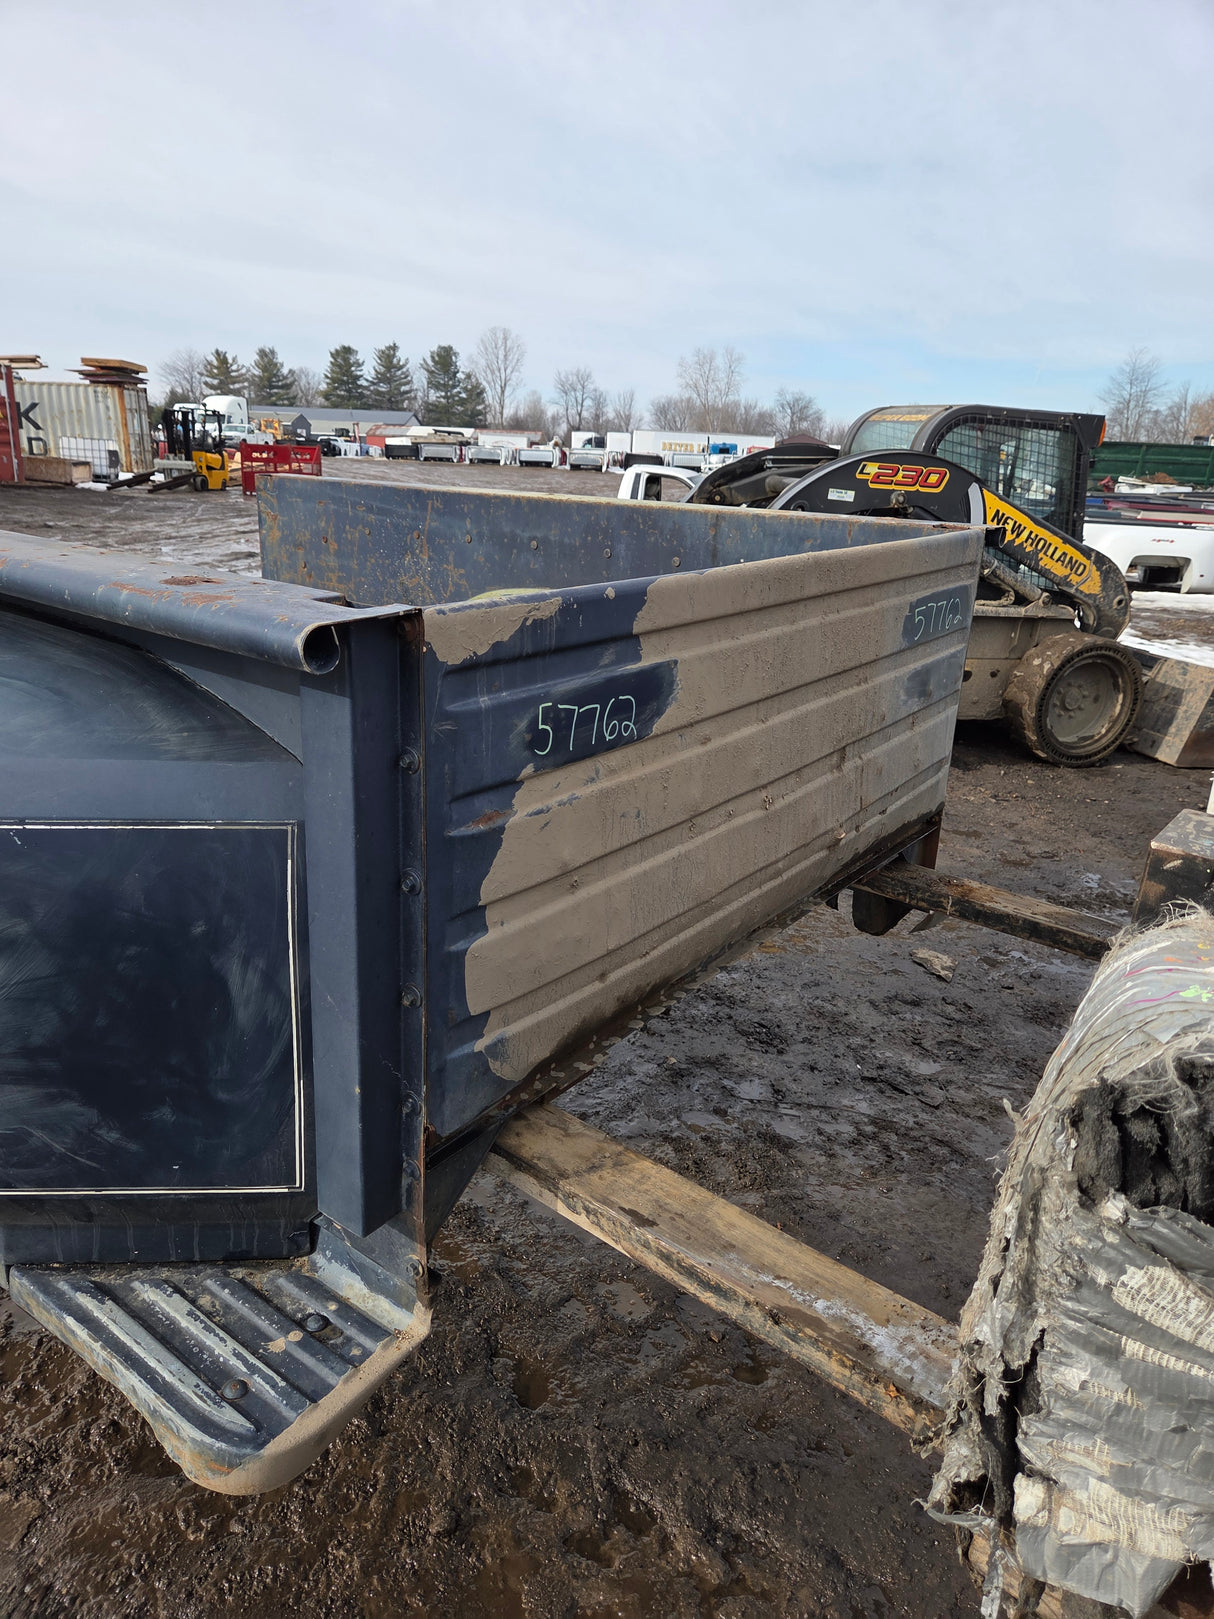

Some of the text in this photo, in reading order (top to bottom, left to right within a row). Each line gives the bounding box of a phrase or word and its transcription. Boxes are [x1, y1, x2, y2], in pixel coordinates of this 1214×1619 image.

[857, 462, 949, 491] L230
[1025, 530, 1087, 577] HOLLAND
[914, 598, 962, 640] 57762
[534, 695, 637, 756] 57762
